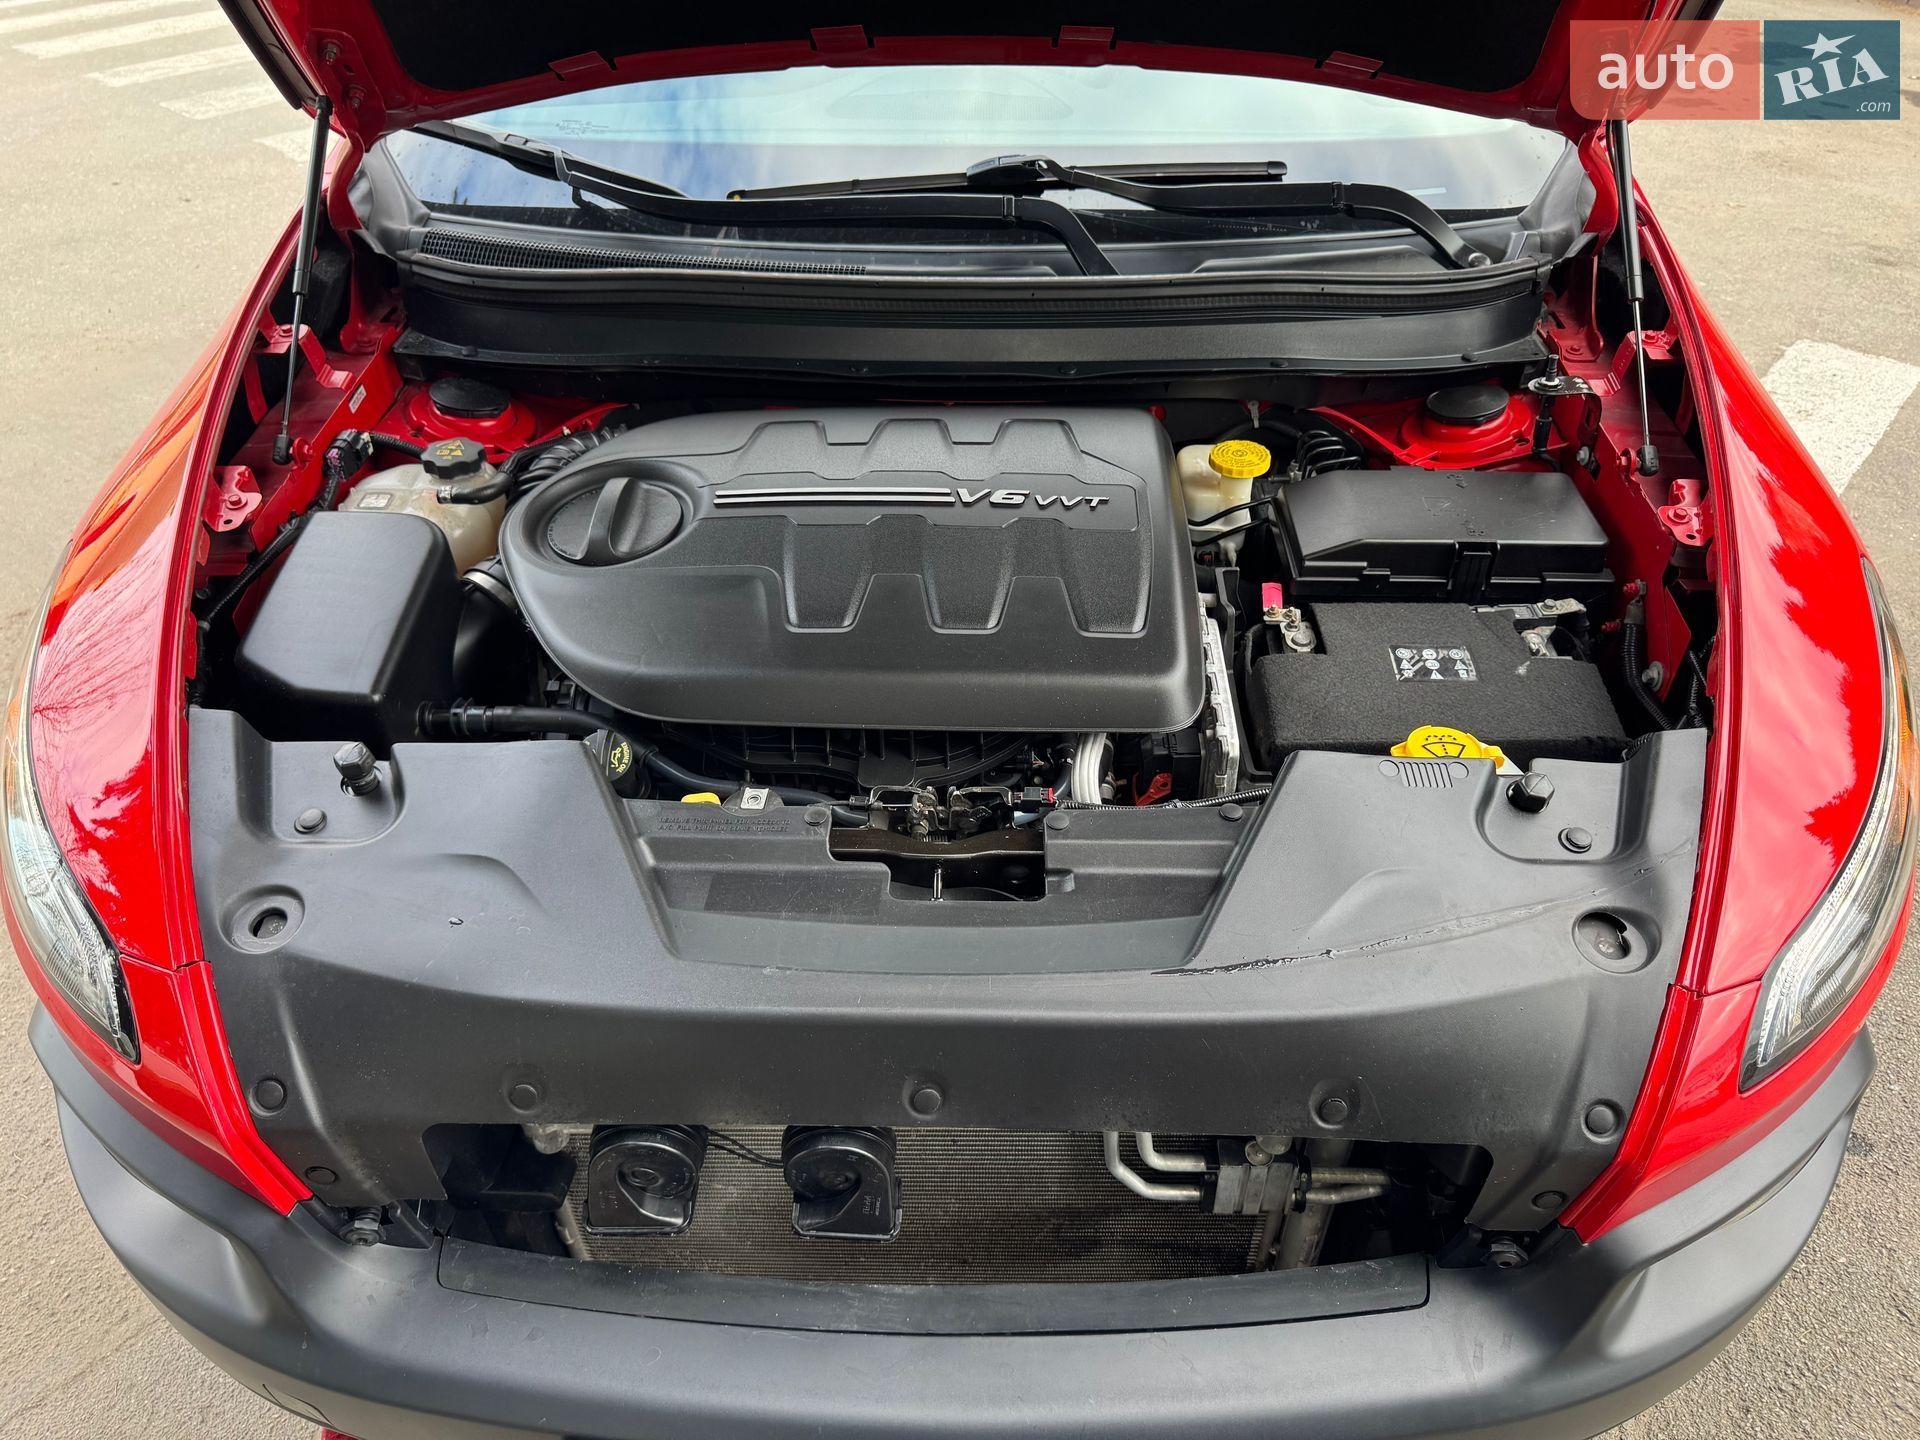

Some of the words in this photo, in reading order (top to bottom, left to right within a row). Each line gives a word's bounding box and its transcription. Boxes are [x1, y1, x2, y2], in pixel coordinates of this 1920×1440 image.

[956, 488, 1031, 507] V6
[1034, 495, 1110, 511] VVT
[621, 742, 630, 763] ENGINE
[616, 763, 626, 773] OIL
